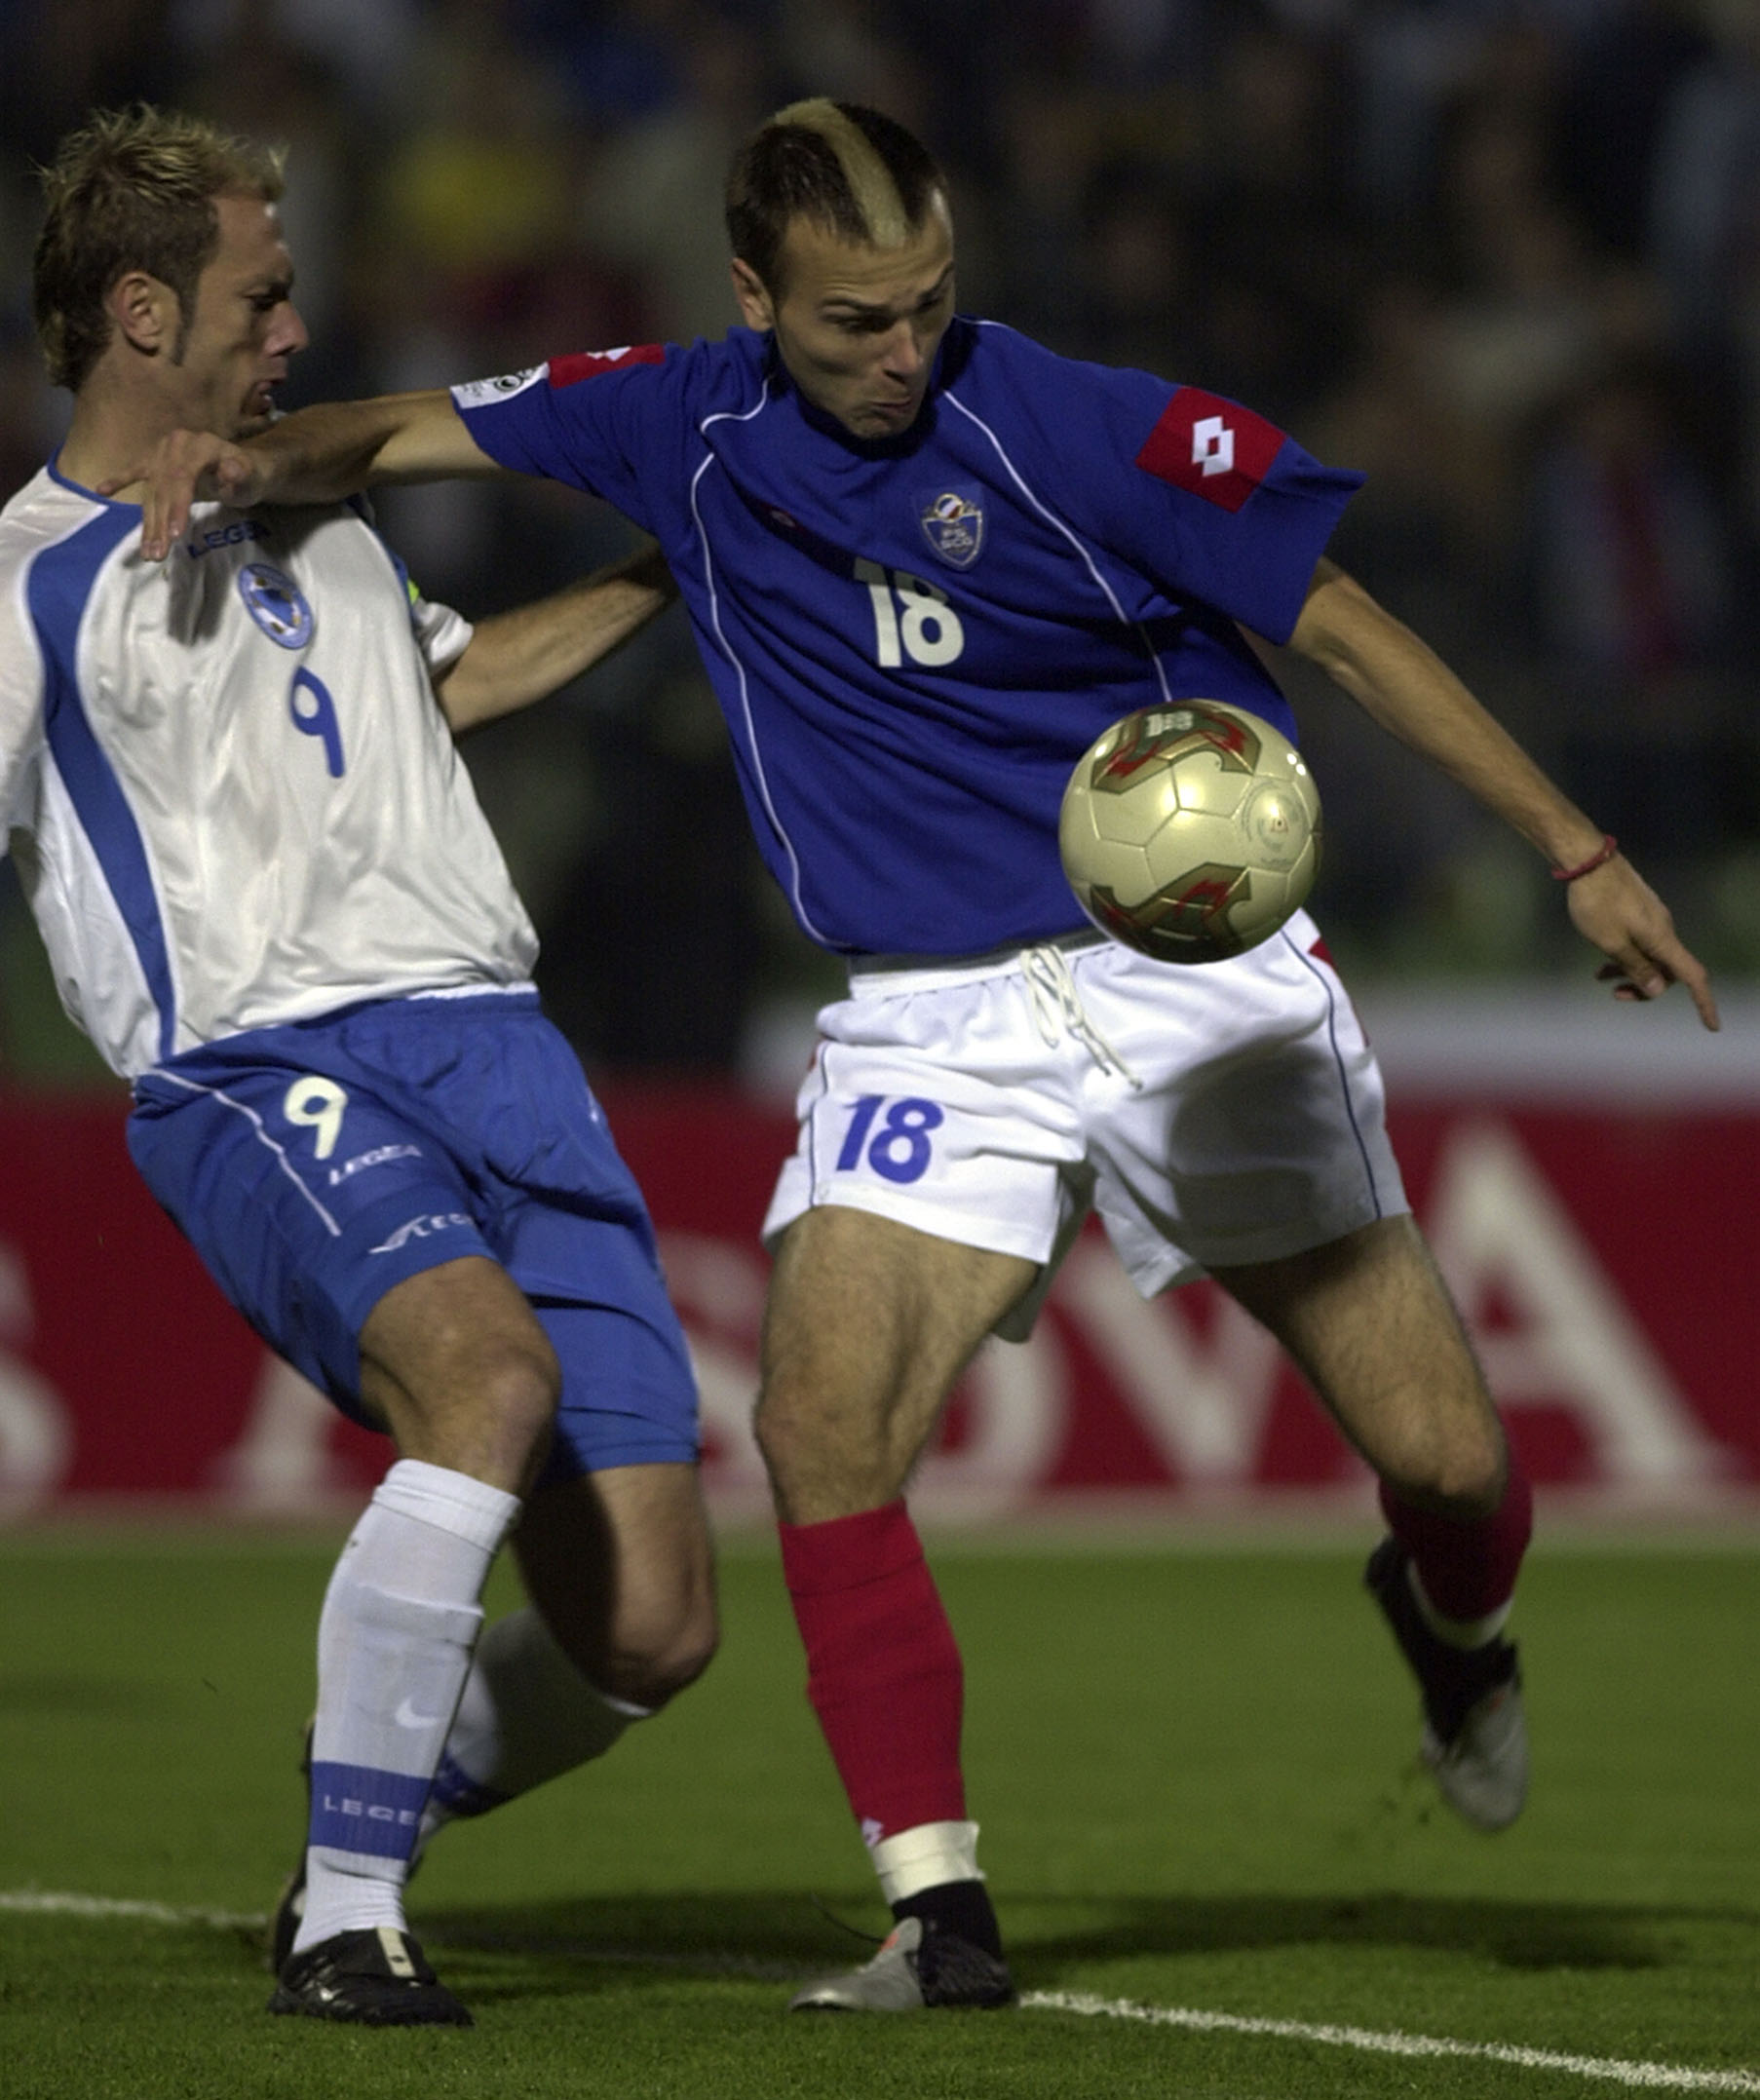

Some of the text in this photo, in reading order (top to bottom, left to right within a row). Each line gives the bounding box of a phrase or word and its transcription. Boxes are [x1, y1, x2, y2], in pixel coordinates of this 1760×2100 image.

[854, 556, 964, 668] 18
[290, 666, 345, 779] 9
[284, 1076, 348, 1160] 9
[836, 1094, 943, 1184] 18
